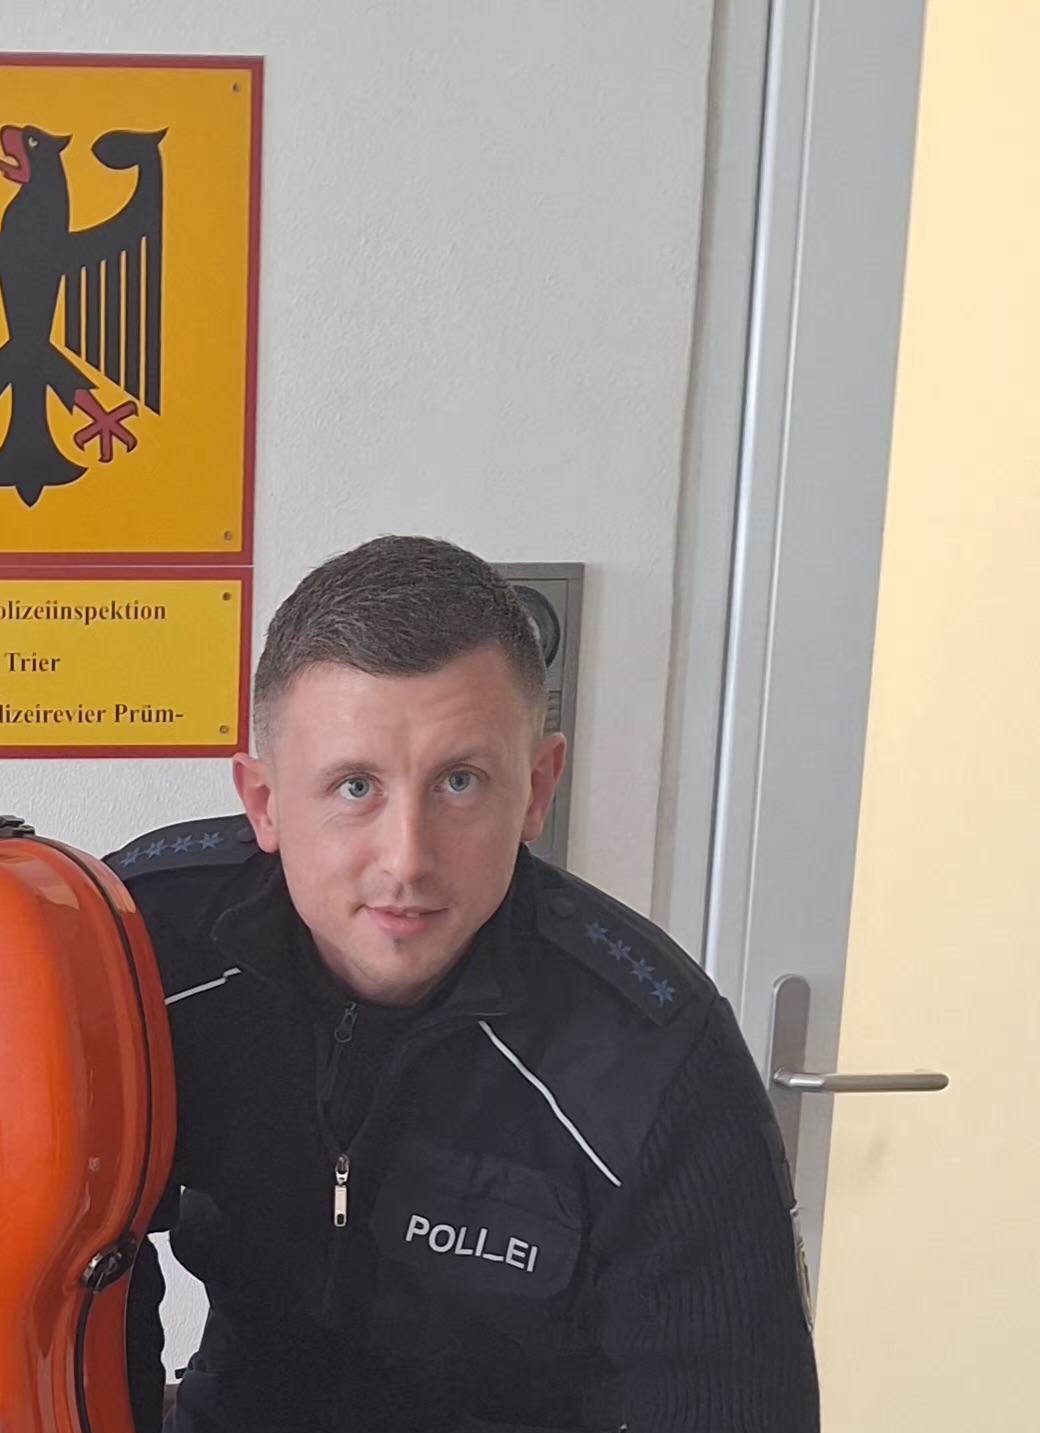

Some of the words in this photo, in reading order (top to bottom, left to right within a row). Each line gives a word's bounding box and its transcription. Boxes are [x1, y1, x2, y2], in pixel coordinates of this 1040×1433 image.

[4, 651, 61, 673] Trier
[113, 703, 185, 724] Prüm-
[405, 1214, 539, 1273] POLIEI
